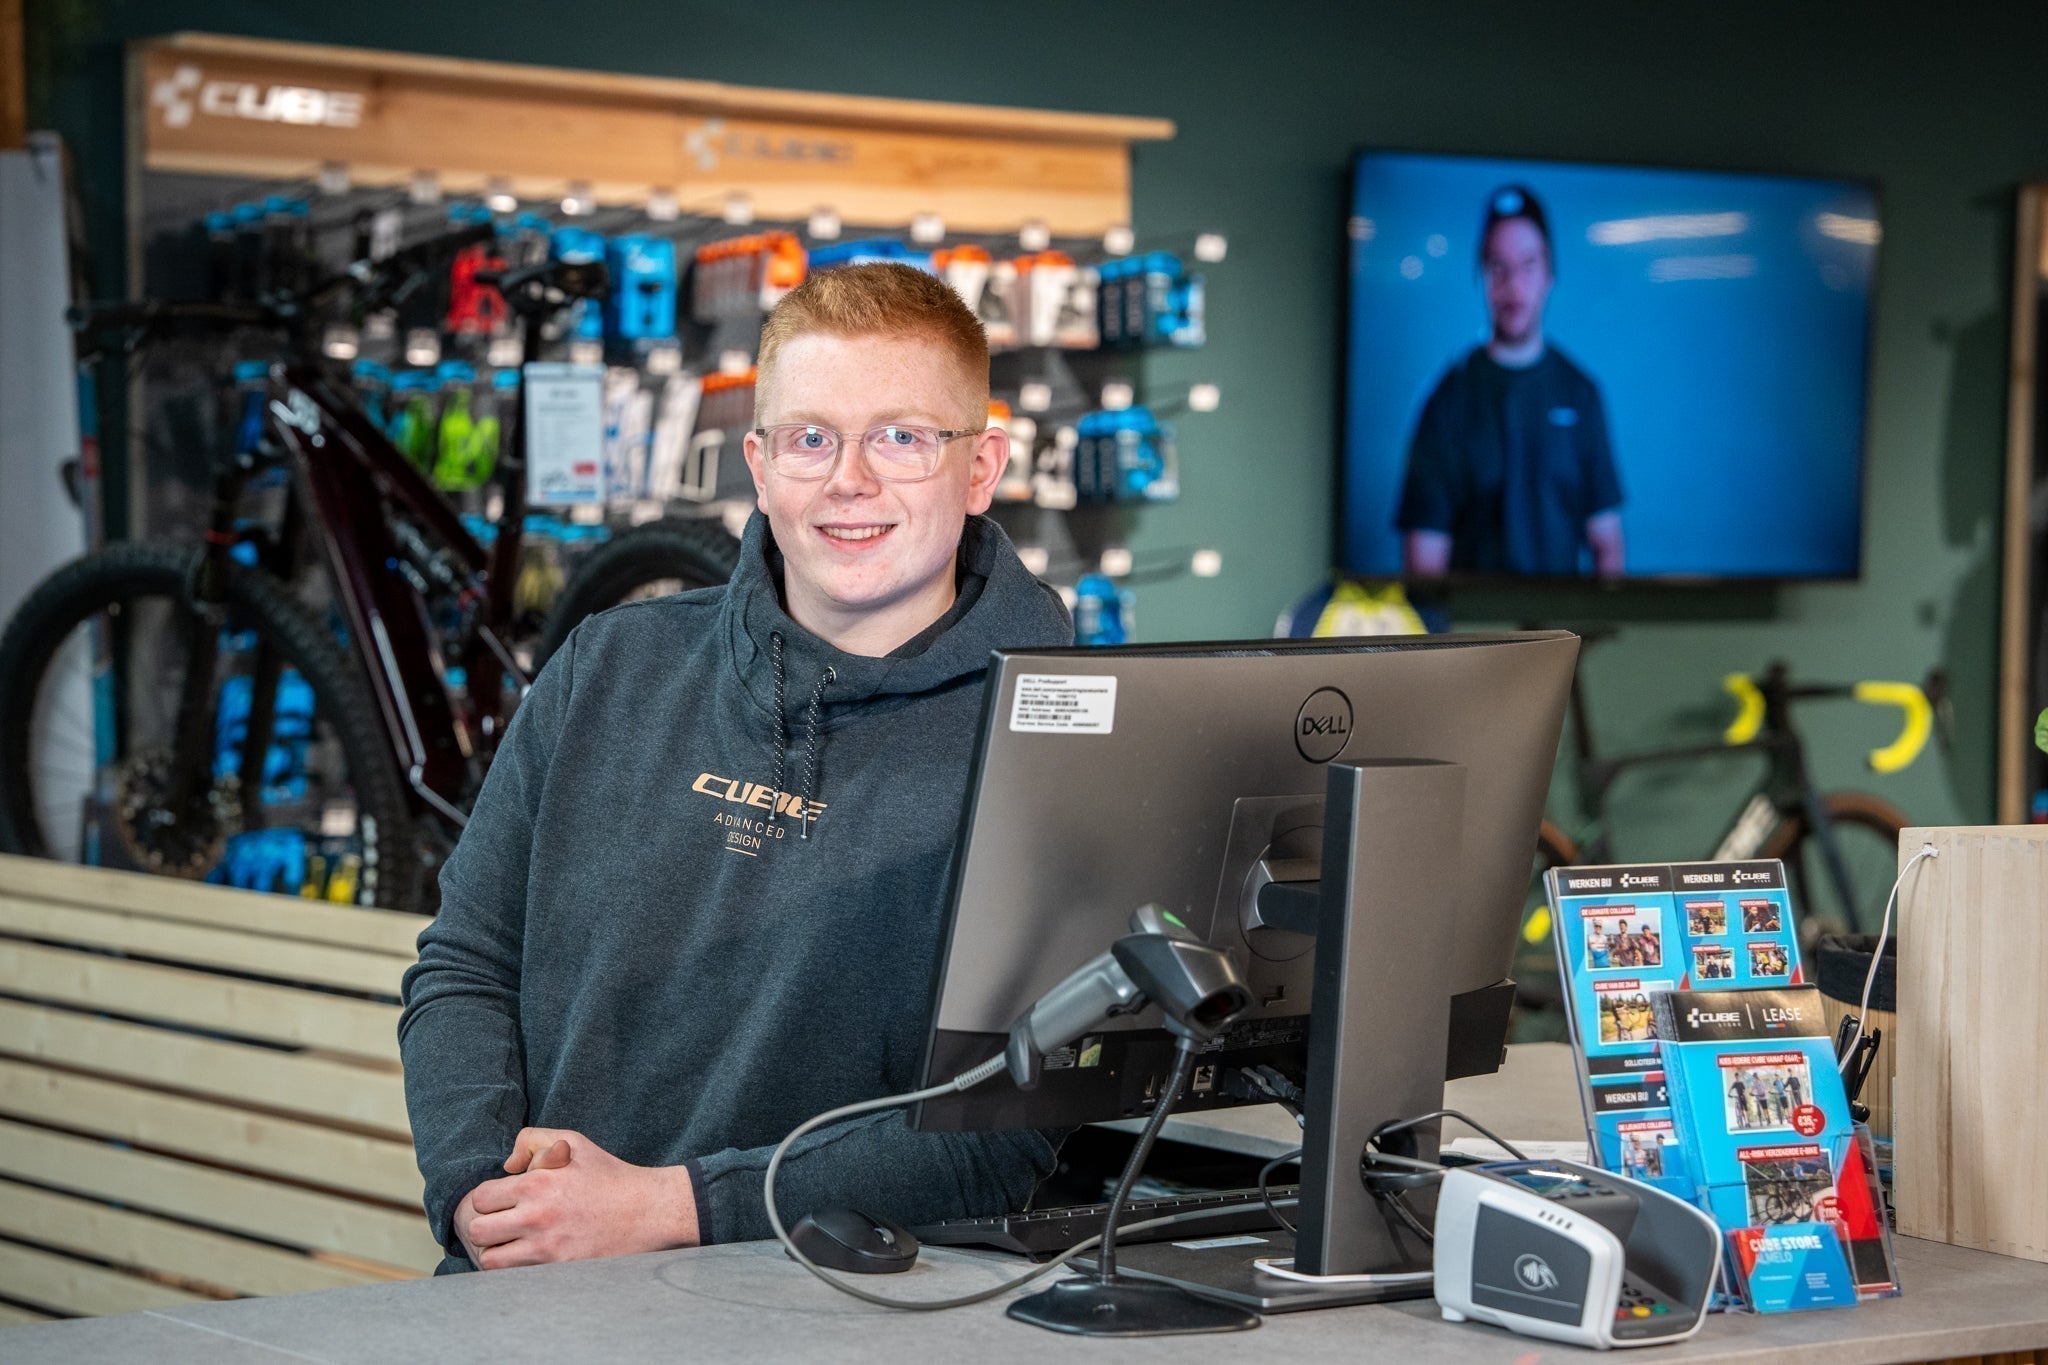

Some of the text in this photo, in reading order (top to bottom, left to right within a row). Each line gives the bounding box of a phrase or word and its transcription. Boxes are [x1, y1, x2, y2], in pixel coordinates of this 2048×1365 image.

[201, 81, 364, 128] CUBE
[1302, 716, 1346, 735] DELL
[692, 772, 828, 821] CUBE
[727, 831, 762, 850] DESIGN
[1568, 878, 1601, 889] WERKEN
[1629, 876, 1660, 884] CUBE
[1683, 874, 1714, 884] WERKEN
[1741, 872, 1771, 880] CUBE
[1699, 1007, 1803, 1023] CUBE LEASE
[1605, 1092, 1638, 1104] WERKEN
[1750, 1235, 1823, 1252] CUBE STORE
